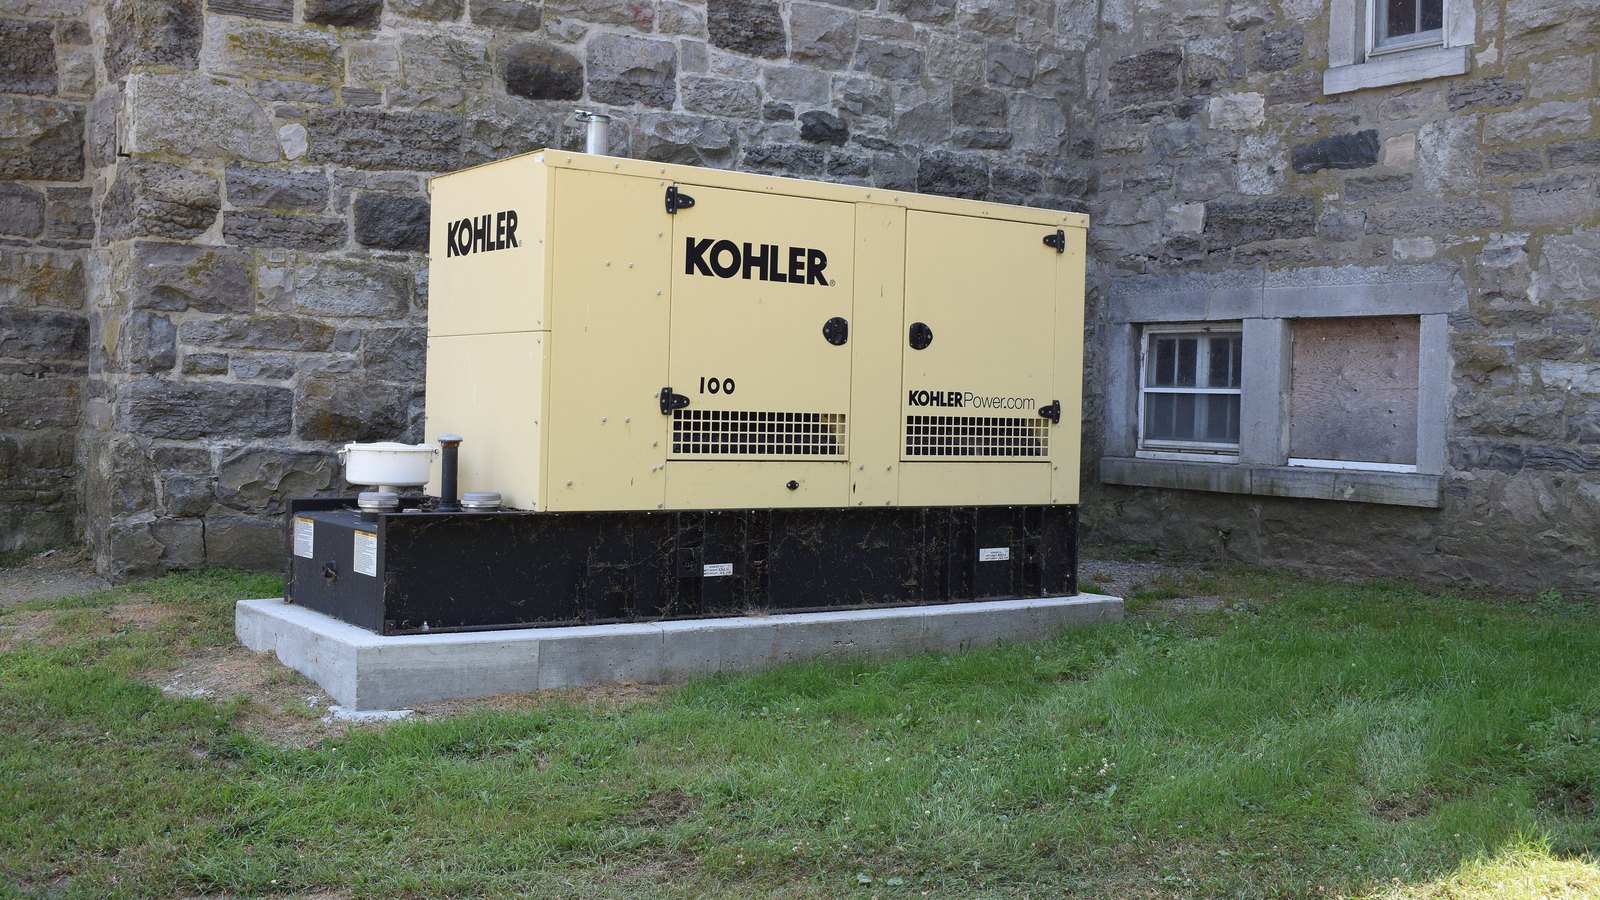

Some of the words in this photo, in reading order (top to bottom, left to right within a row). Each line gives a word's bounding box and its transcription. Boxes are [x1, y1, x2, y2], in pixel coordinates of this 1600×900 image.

[447, 210, 518, 258] KOHLER
[700, 376, 735, 395] 100
[909, 390, 1035, 410] KOHLERPower.com
